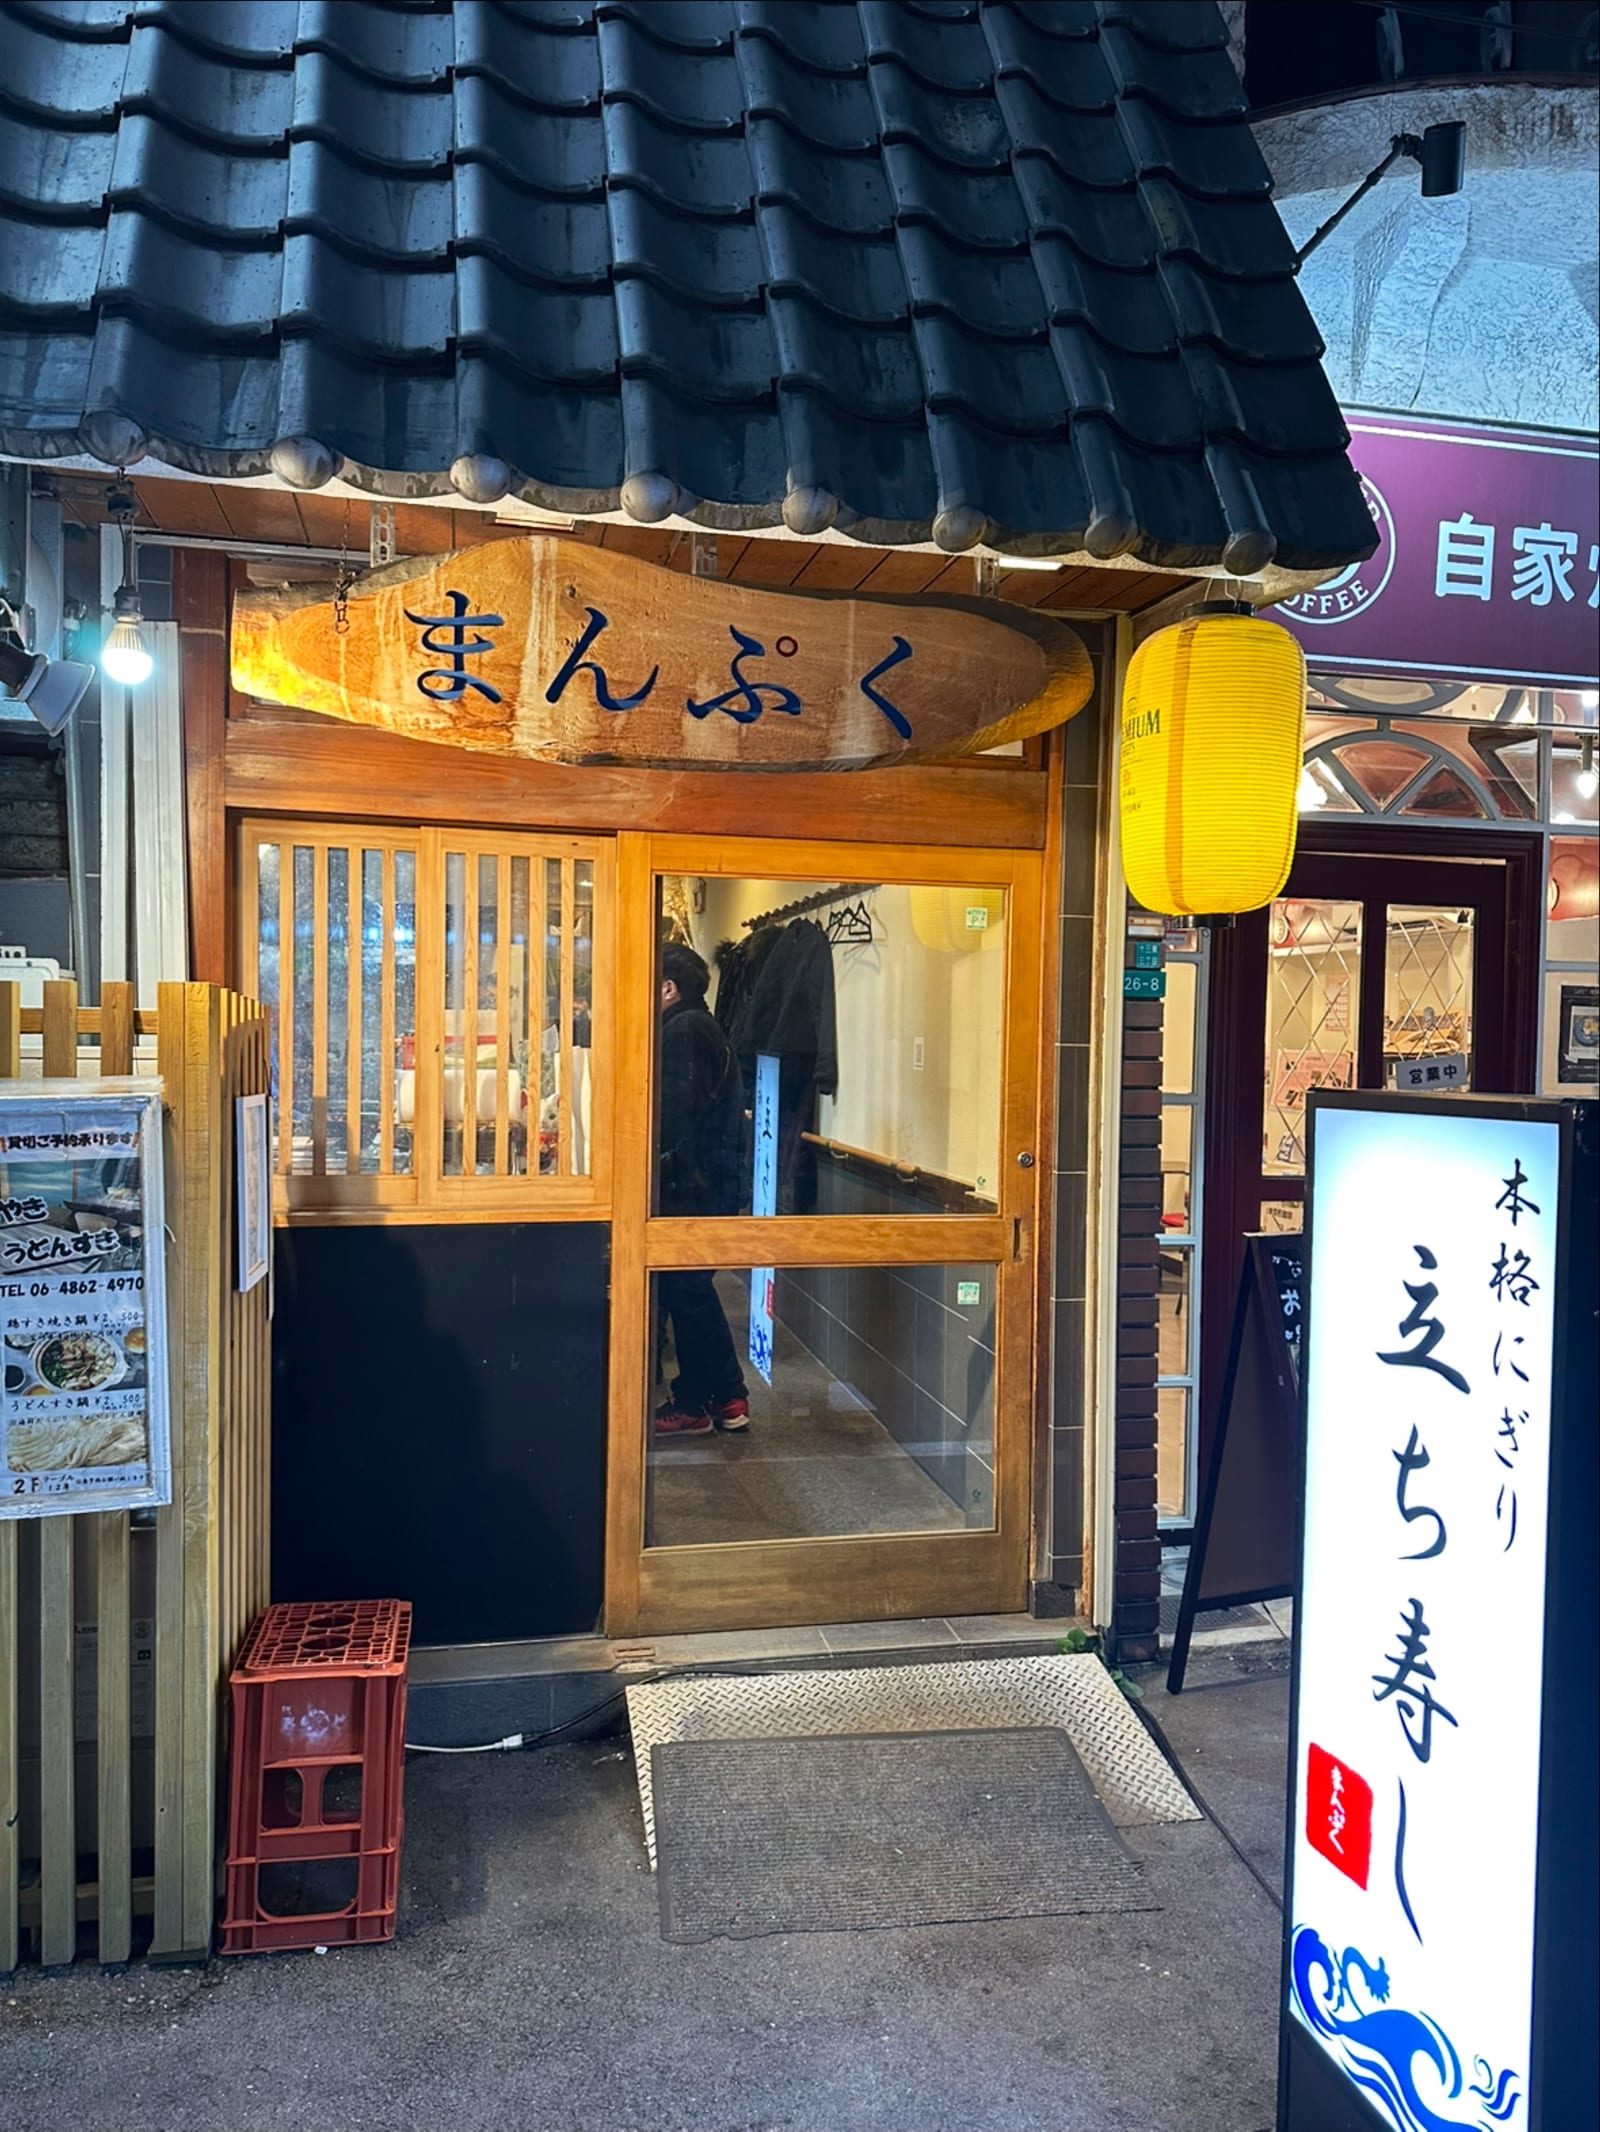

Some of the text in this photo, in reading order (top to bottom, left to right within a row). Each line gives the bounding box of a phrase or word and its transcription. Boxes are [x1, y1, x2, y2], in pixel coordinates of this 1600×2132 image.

[1435, 512, 1599, 608] 自家
[404, 591, 912, 740] まんぷく
[1124, 977, 1160, 992] 26-8
[1409, 1064, 1457, 1085] 営業中
[4, 1229, 119, 1264] うどんすき
[0, 1284, 26, 1298] TEL
[1489, 1158, 1541, 1552] 本格にぎり
[1371, 1245, 1471, 1946] 立ち寿し
